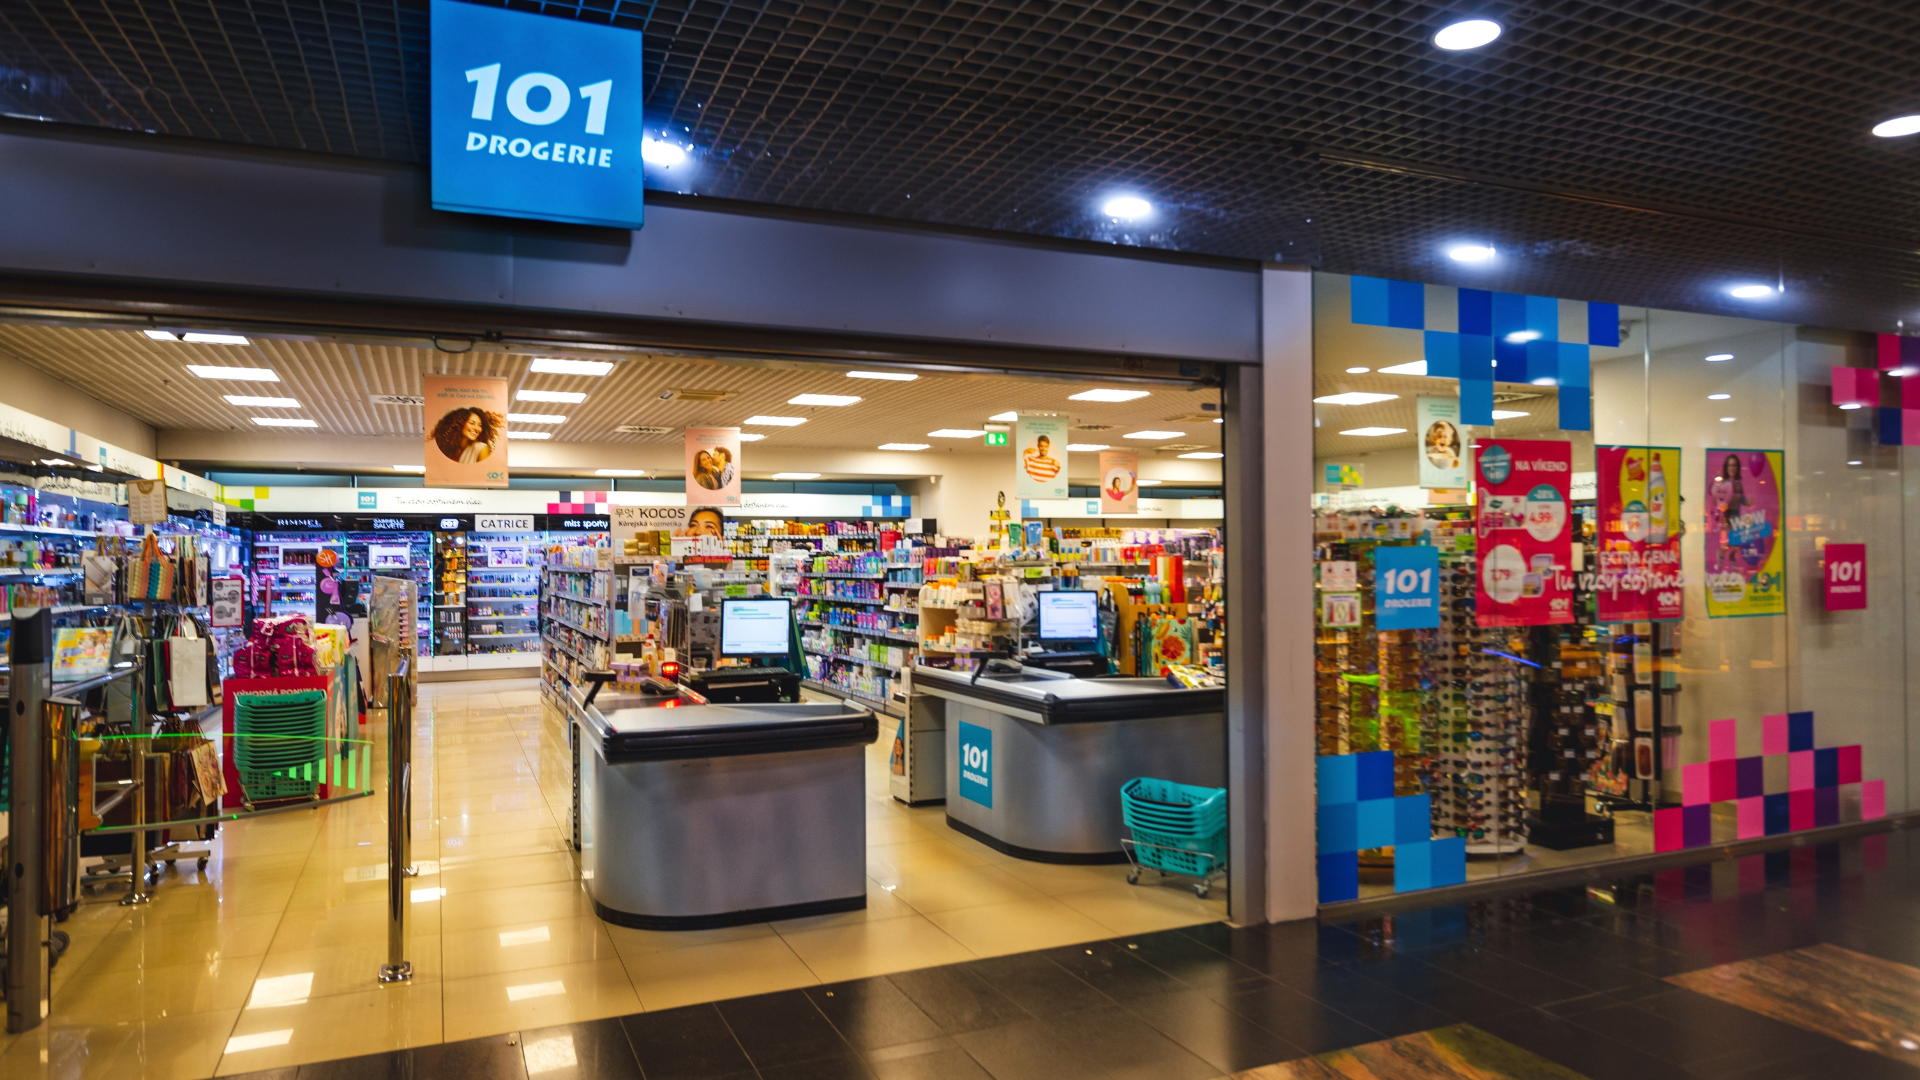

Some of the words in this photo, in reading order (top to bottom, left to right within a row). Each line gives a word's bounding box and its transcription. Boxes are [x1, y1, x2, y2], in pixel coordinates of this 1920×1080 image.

[465, 63, 612, 135] 101
[466, 131, 613, 168] DROGERIE
[1515, 460, 1530, 471] NA
[1531, 458, 1569, 472] VÍKEND
[481, 519, 529, 529] CATRICE
[564, 520, 581, 528] miss
[582, 519, 609, 529] sporty
[638, 507, 686, 519] KOCOS
[1729, 509, 1766, 531] WOW
[1600, 550, 1640, 566] EXTRA
[1384, 568, 1432, 595] 101
[1549, 565, 1576, 591] Tu
[1829, 560, 1862, 583] 101
[1384, 598, 1432, 608] DROGERIE
[963, 743, 988, 773] 101
